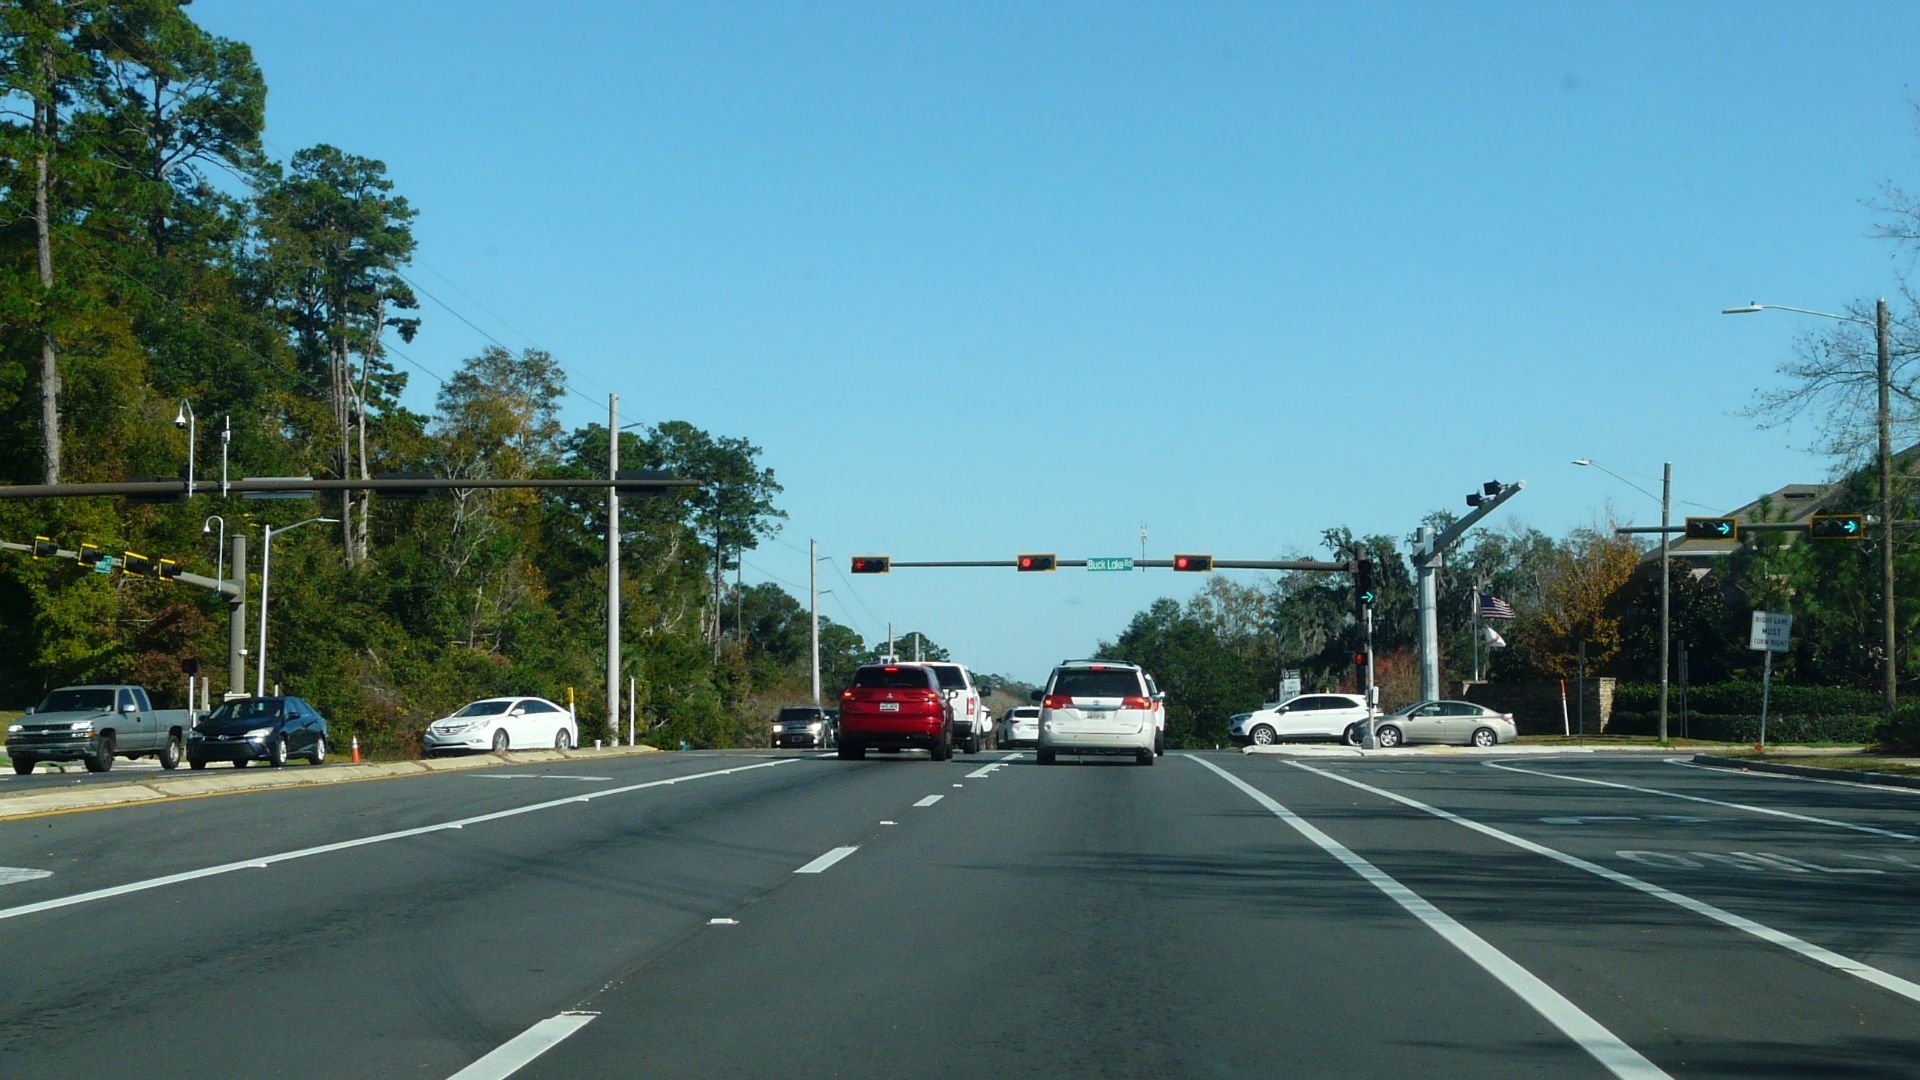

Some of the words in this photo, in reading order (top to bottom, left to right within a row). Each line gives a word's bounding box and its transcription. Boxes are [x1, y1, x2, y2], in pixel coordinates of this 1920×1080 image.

[1088, 560, 1106, 570] Buck
[1107, 559, 1124, 570] Lake
[1755, 616, 1773, 625] RIGHT
[1761, 628, 1782, 636] MUST
[1753, 638, 1769, 646] TURN
[1770, 639, 1787, 648] RIGHT
